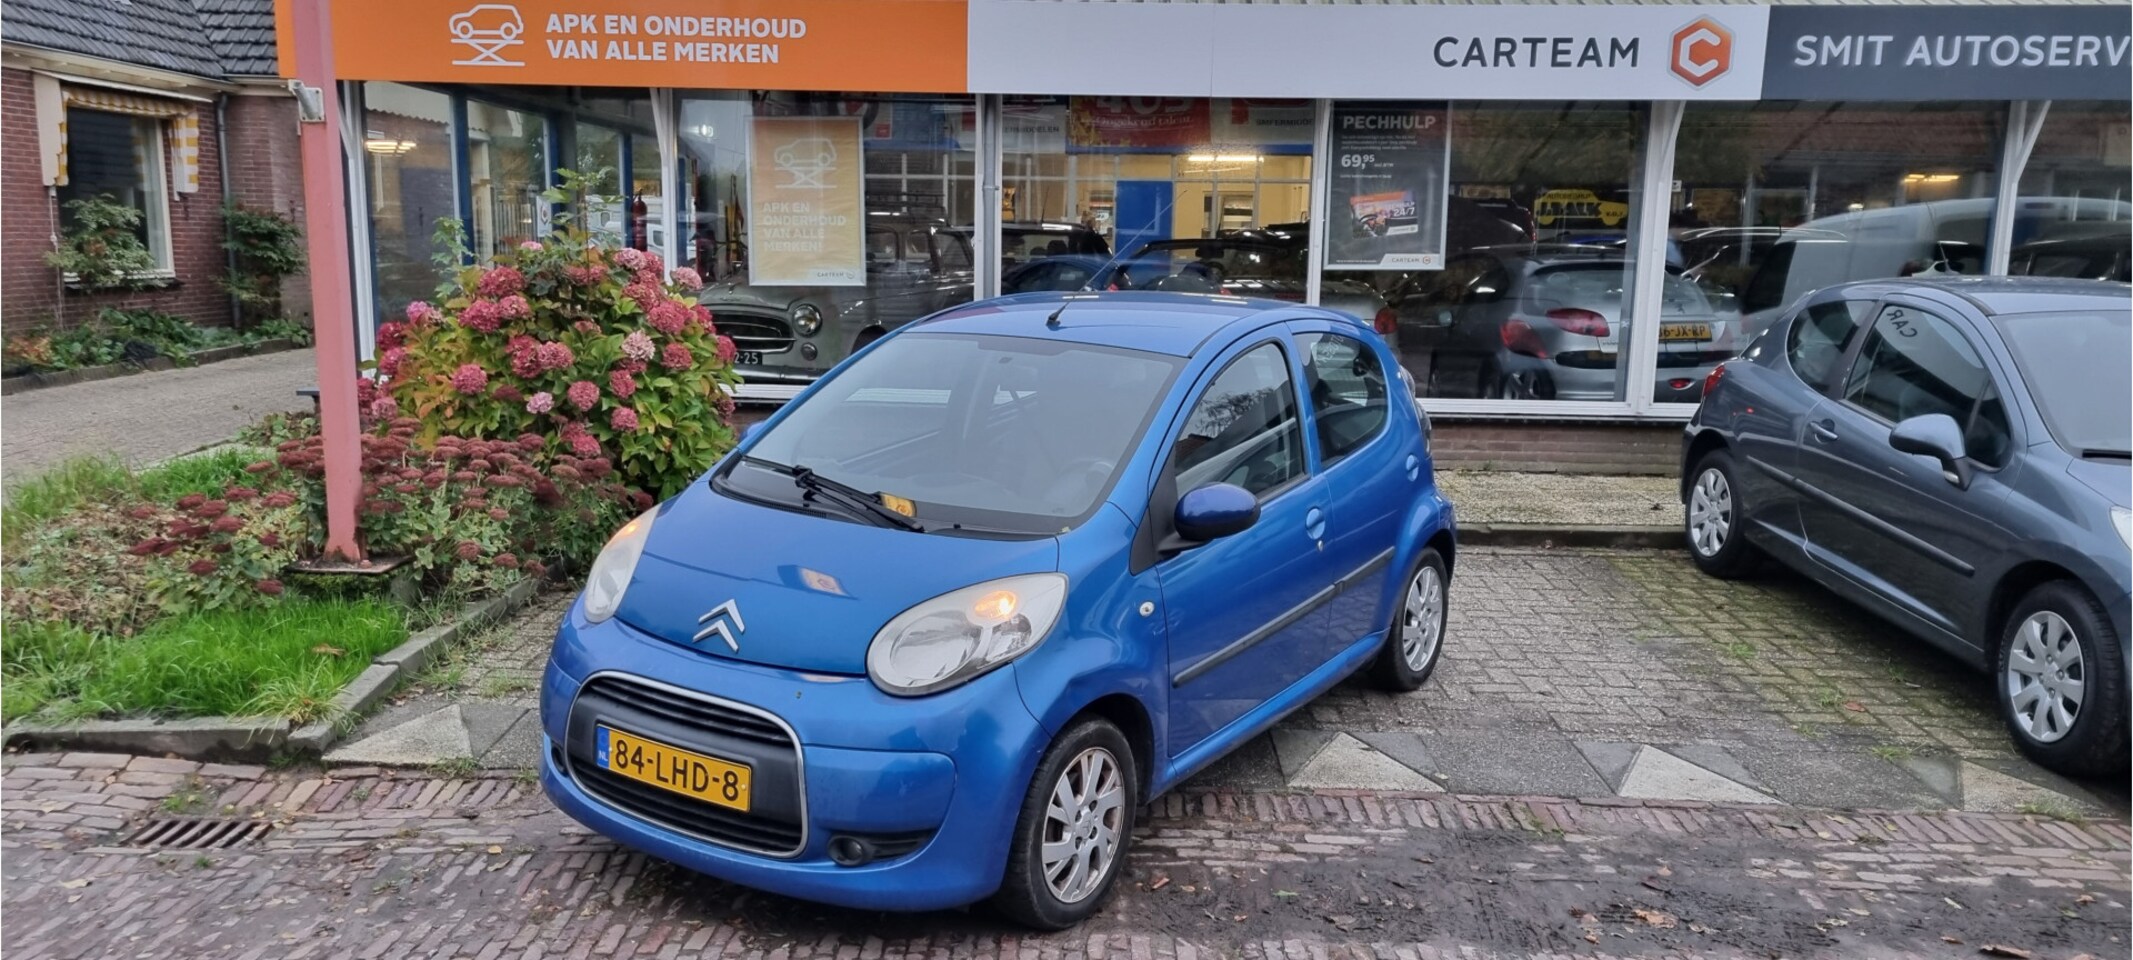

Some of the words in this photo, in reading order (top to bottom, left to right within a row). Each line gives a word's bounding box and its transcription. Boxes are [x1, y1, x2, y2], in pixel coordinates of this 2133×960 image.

[546, 14, 597, 33] APK
[604, 15, 637, 34] EN
[644, 16, 806, 38] ONDERHOUD
[547, 40, 598, 59] VAN
[605, 41, 667, 61] ALLE
[674, 42, 779, 63] MERKEN
[1433, 36, 1640, 68] CARTEAM
[1794, 35, 1893, 66] SMIT
[1905, 35, 2132, 66] AUTOSERV
[1343, 115, 1436, 129] PECHHULP
[763, 202, 789, 212] APK
[793, 201, 810, 212] EN
[1393, 207, 1415, 216] 24/7
[764, 215, 846, 226] ONDERHOUD
[763, 228, 790, 239] VAN
[793, 228, 825, 239] ALLE
[598, 750, 608, 762] NL
[616, 739, 739, 801] 84-LHD-8
